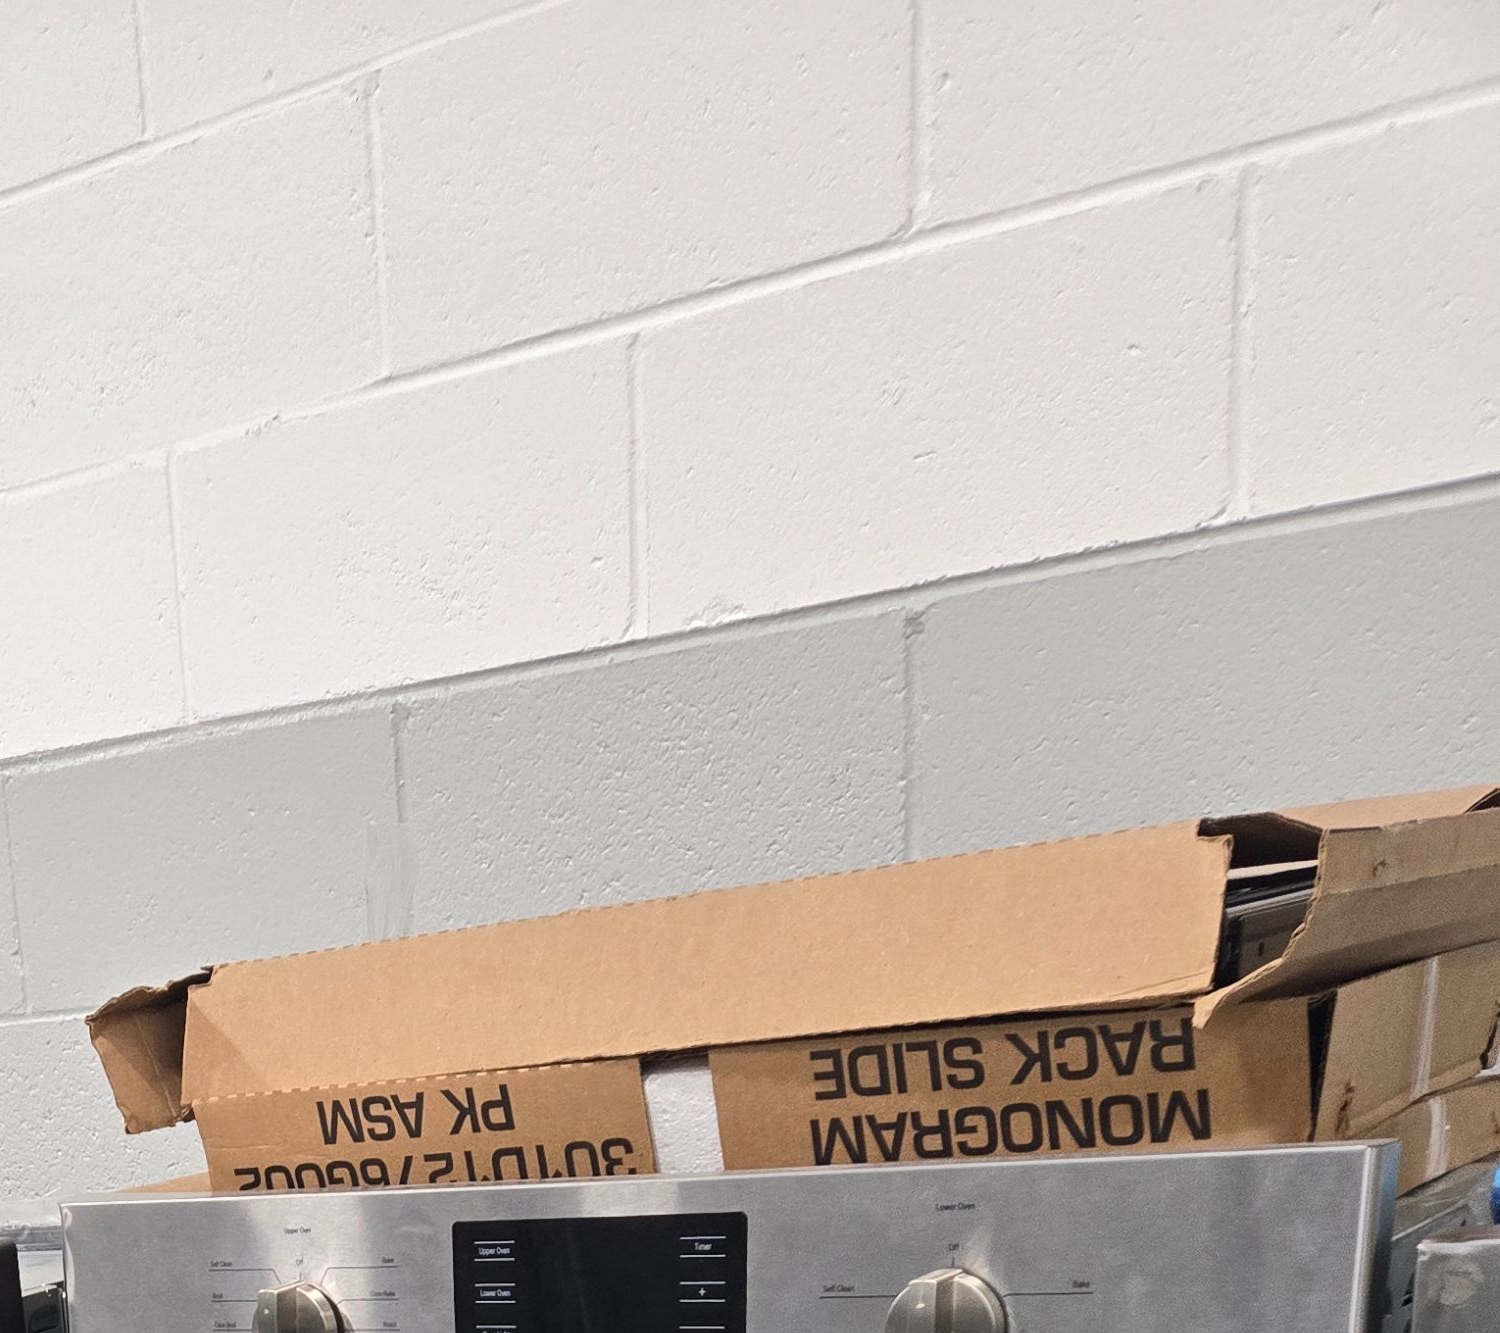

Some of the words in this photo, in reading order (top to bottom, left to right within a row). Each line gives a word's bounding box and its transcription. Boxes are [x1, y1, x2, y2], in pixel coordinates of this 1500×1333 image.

[810, 1037, 986, 1101] SLIDE
[1006, 1017, 1196, 1086] RACK
[316, 1091, 425, 1145] ASM
[440, 1084, 516, 1136] PK
[810, 1088, 1213, 1166] MONOGRAM
[957, 1202, 976, 1210] Oven
[496, 1246, 510, 1254] Oven
[496, 1288, 511, 1297] Oven
